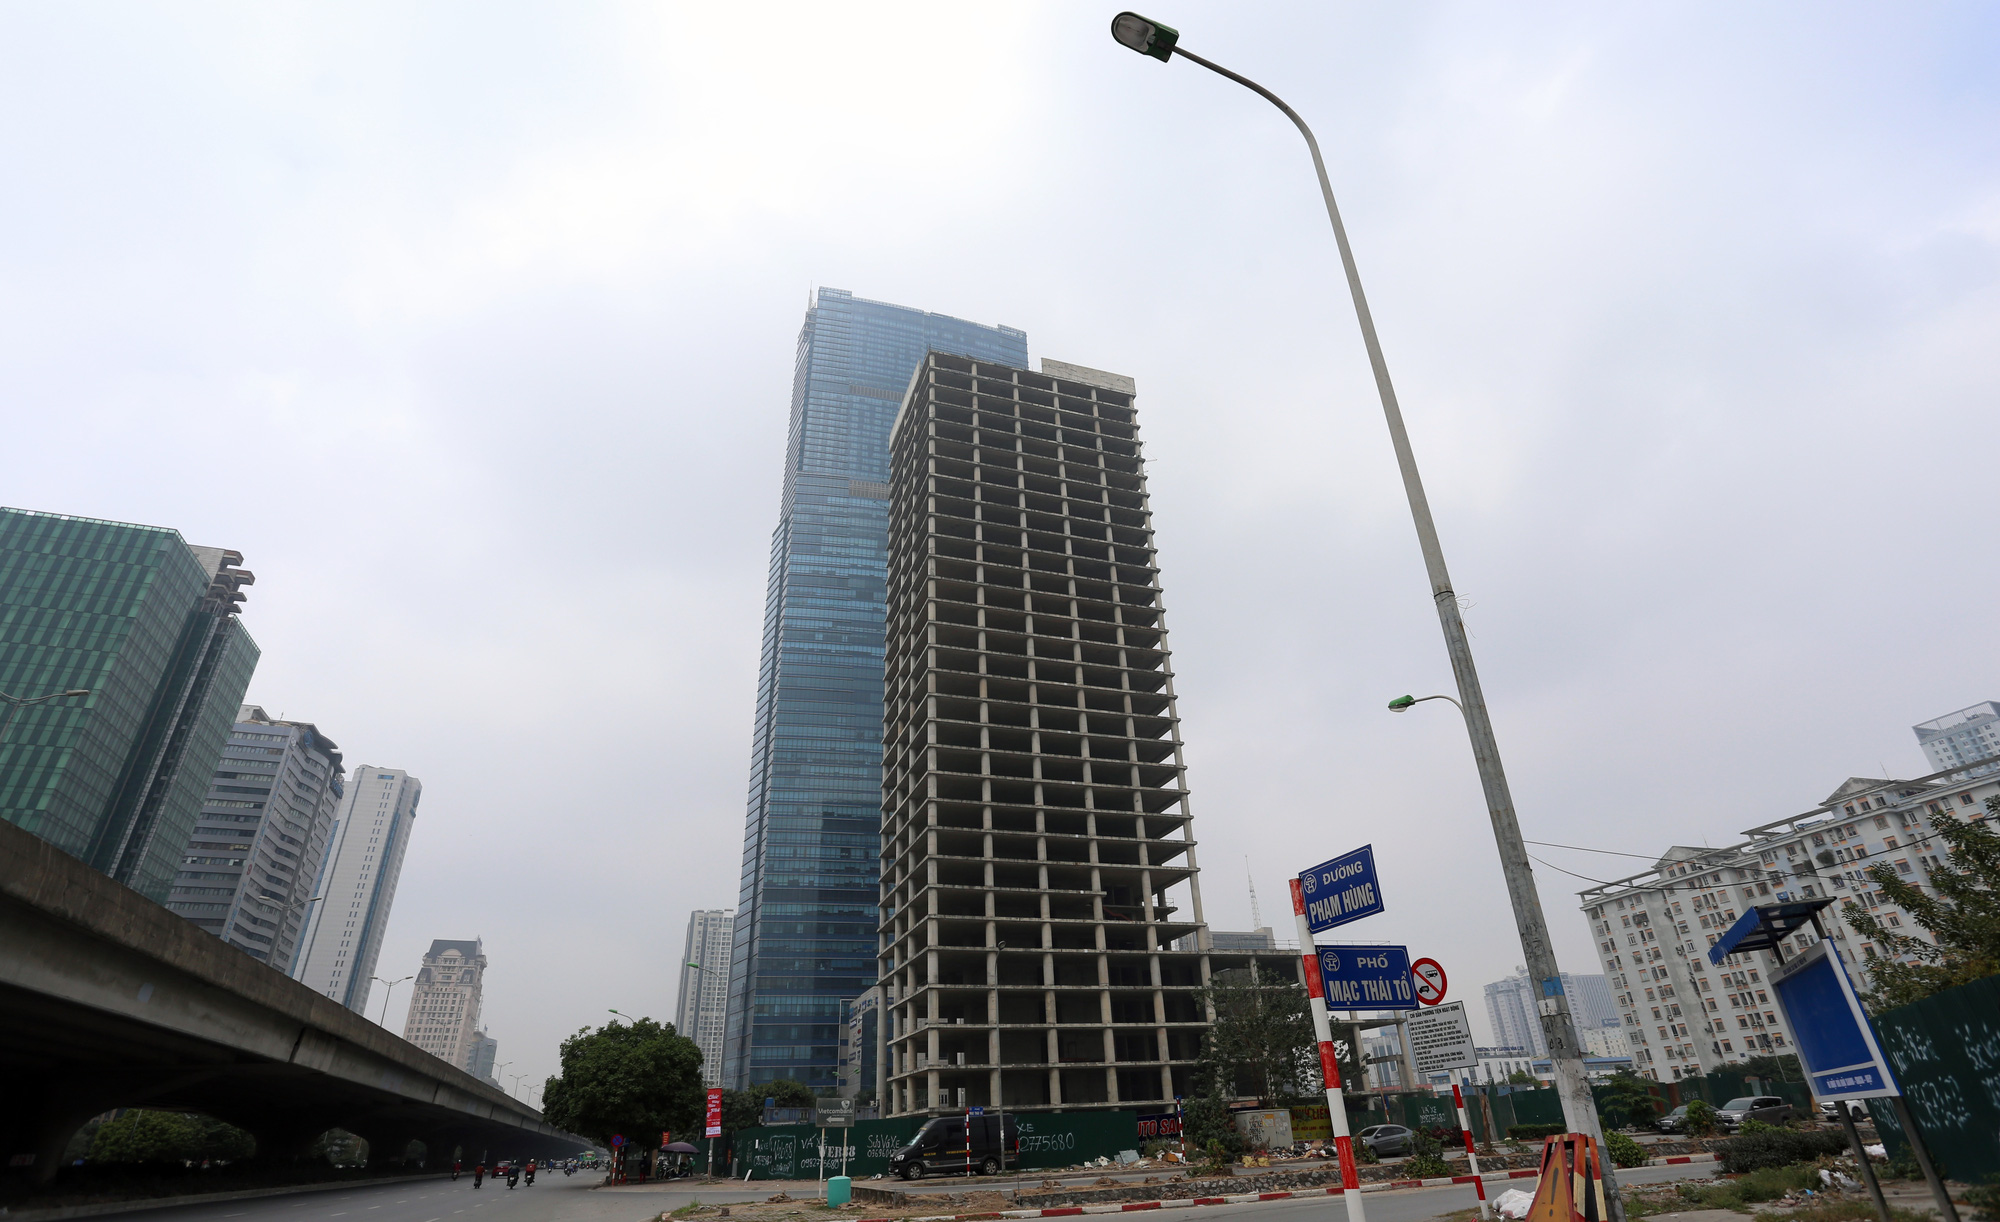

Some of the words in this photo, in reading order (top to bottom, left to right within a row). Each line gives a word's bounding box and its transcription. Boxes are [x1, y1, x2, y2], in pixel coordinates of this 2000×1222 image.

[1322, 861, 1364, 886] ĐƯỜNG
[1309, 894, 1343, 924] PHẠM
[1342, 882, 1376, 913] HÙNG
[1356, 952, 1389, 969] PHỐ
[1328, 980, 1360, 1006] MẠC
[1361, 975, 1393, 1002] THÁI
[1393, 970, 1412, 1001] TỔ
[817, 1107, 854, 1115] Vietcombank
[1016, 1123, 1034, 1135] XE
[800, 1133, 817, 1149] VÁ
[800, 1157, 840, 1170] 098275680
